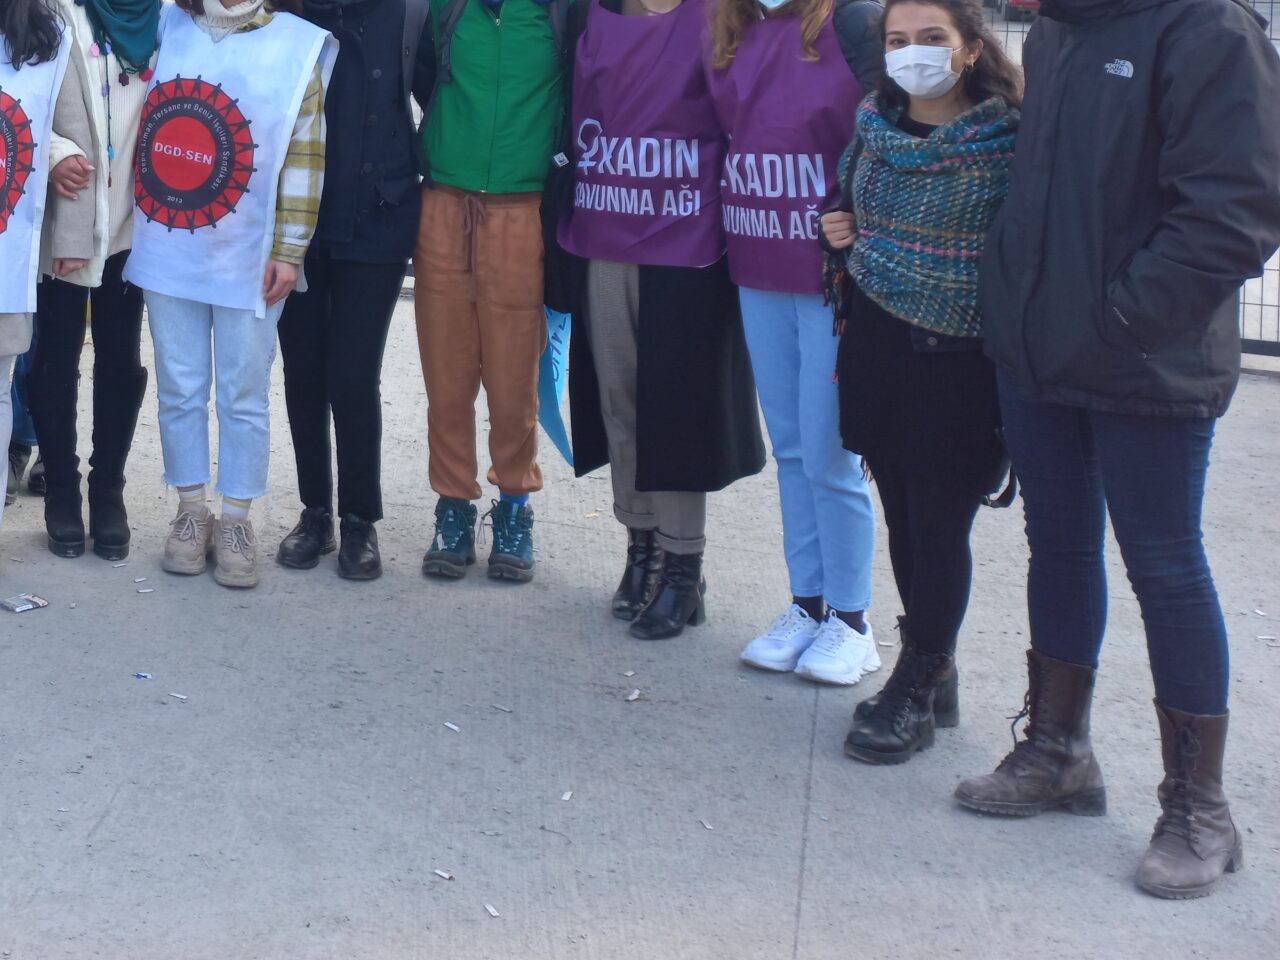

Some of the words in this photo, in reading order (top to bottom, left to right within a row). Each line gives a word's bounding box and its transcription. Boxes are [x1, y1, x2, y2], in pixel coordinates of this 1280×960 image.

[153, 103, 181, 121] Tersane
[183, 102, 192, 110] ve
[193, 103, 213, 119] Deniz
[154, 142, 213, 166] DGD-SEN
[598, 136, 700, 178] KADIN
[725, 153, 826, 198] KADIN
[662, 184, 701, 216] AĞI
